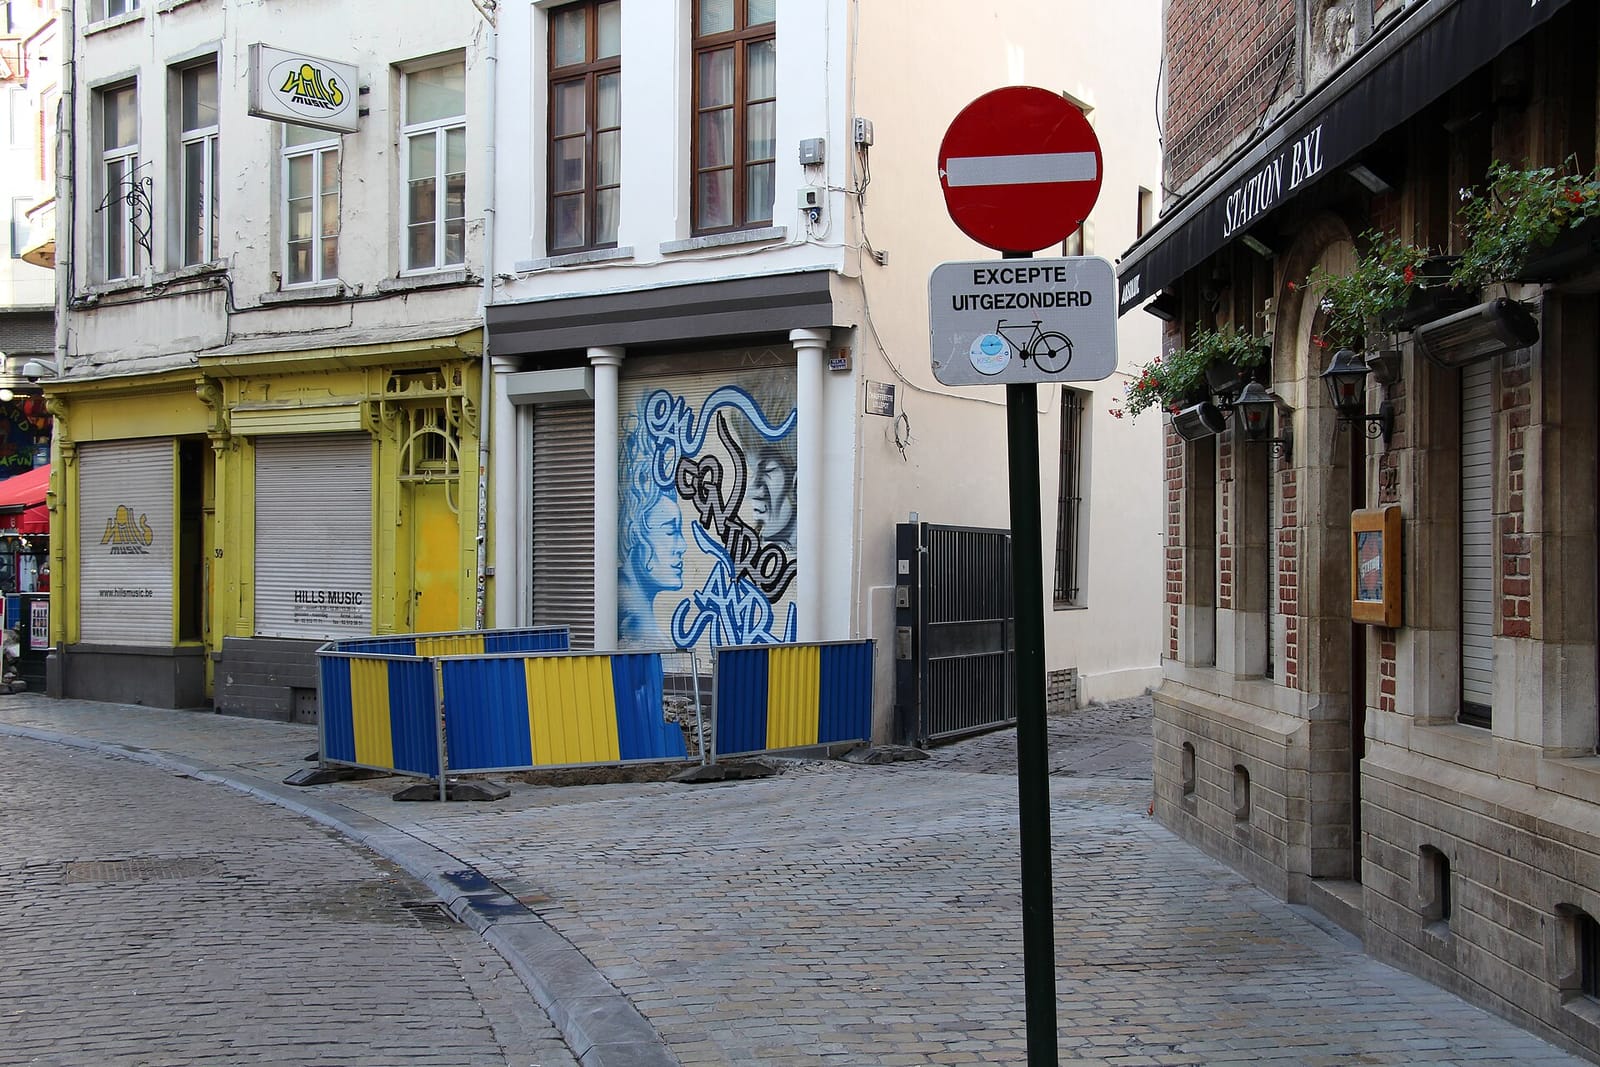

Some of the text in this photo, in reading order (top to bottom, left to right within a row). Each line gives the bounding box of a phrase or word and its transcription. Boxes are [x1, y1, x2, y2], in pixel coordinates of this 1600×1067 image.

[1223, 124, 1324, 239] STATION BXL
[973, 266, 1067, 285] EXCEPTE
[951, 290, 1092, 311] UITGEZONDERD
[98, 587, 153, 598] www.hillsmusic.be
[294, 590, 363, 605] HILLS MUSIC
